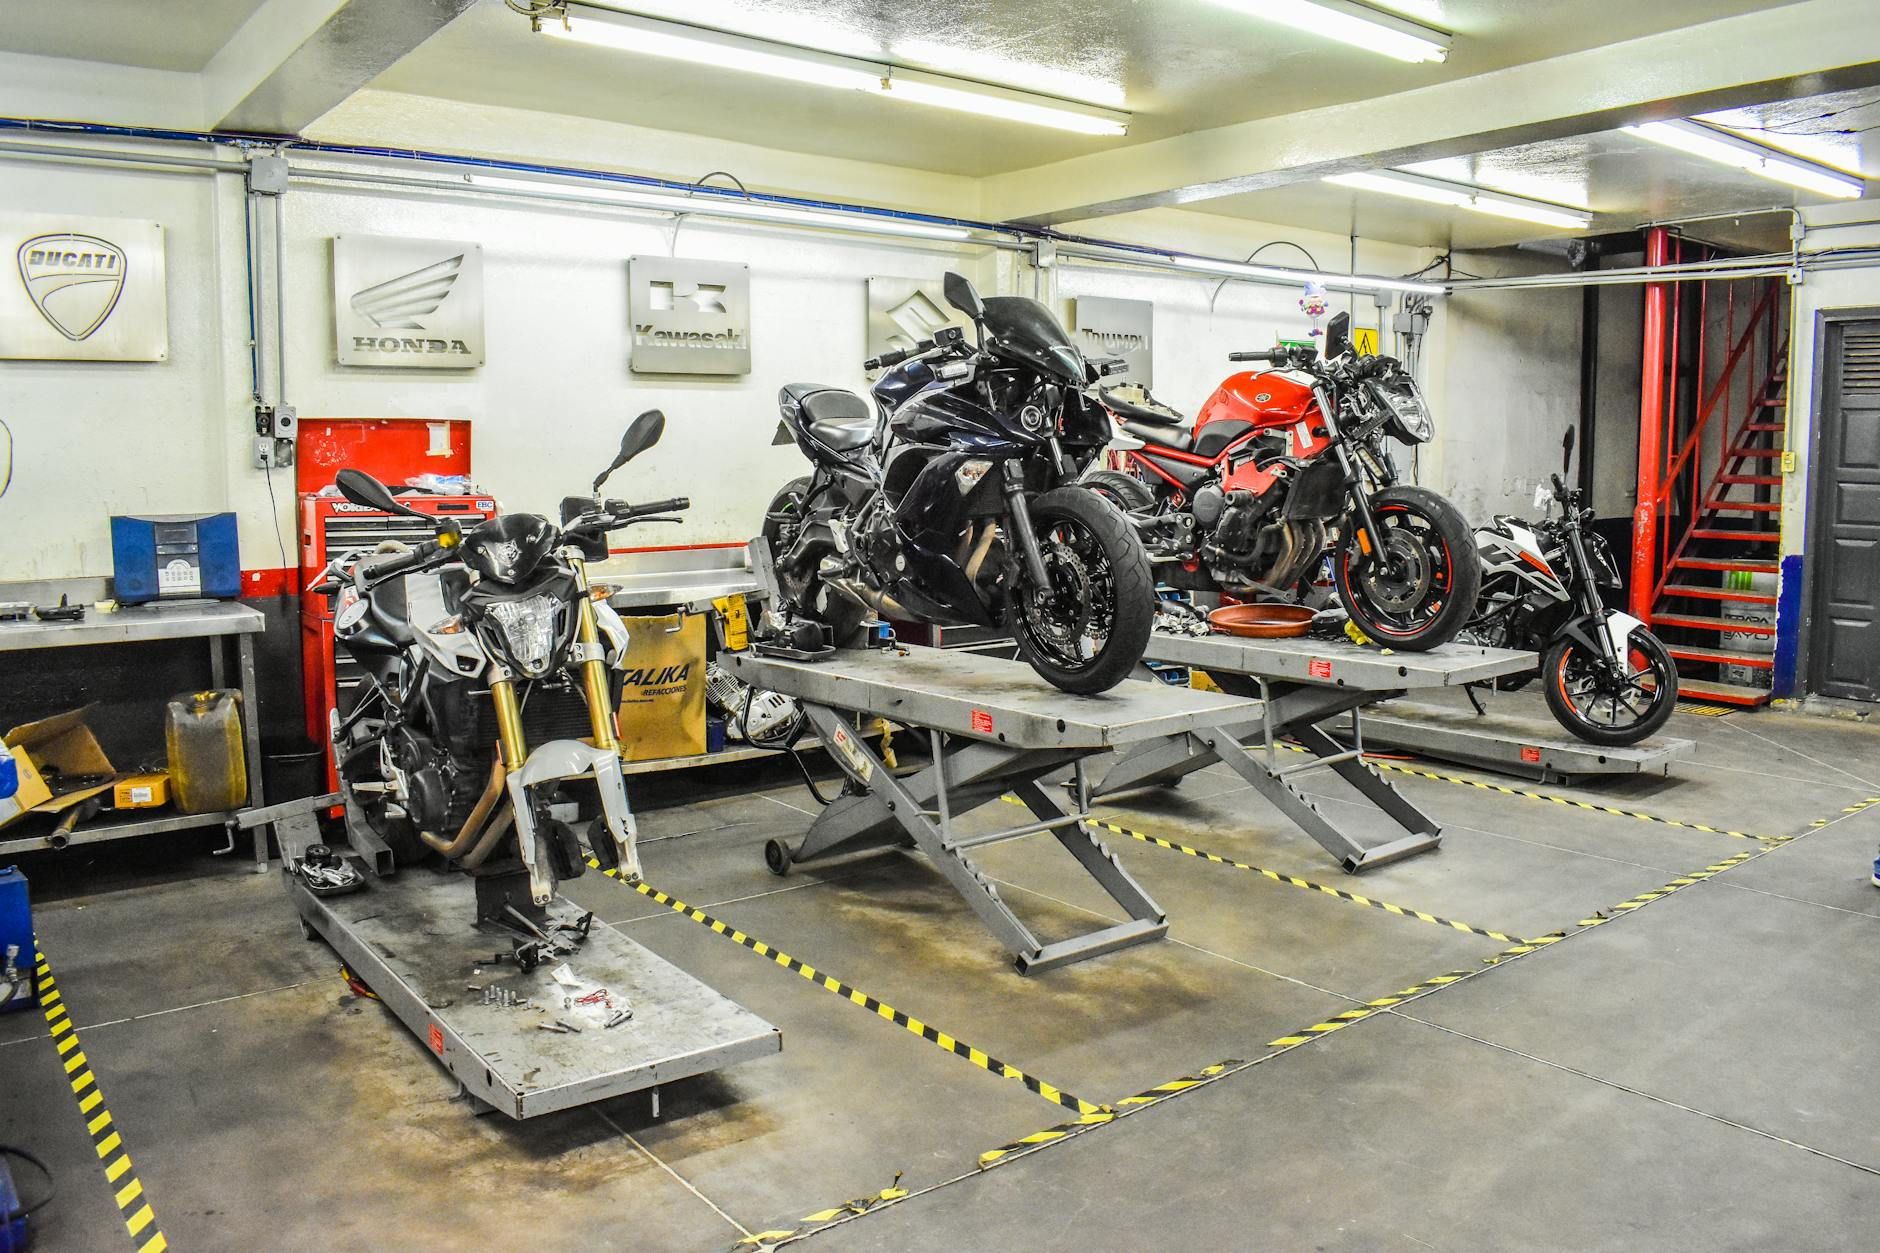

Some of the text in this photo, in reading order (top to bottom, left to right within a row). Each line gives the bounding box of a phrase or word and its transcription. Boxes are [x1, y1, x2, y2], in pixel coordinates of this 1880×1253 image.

[29, 250, 116, 269] DUCATI
[353, 336, 471, 354] HONDA
[636, 324, 747, 349] Kawasaki
[1082, 328, 1149, 351] TRIUMPH
[477, 501, 493, 509] EBC
[622, 663, 690, 686] TALIKA
[642, 685, 687, 697] REFACCIONES
